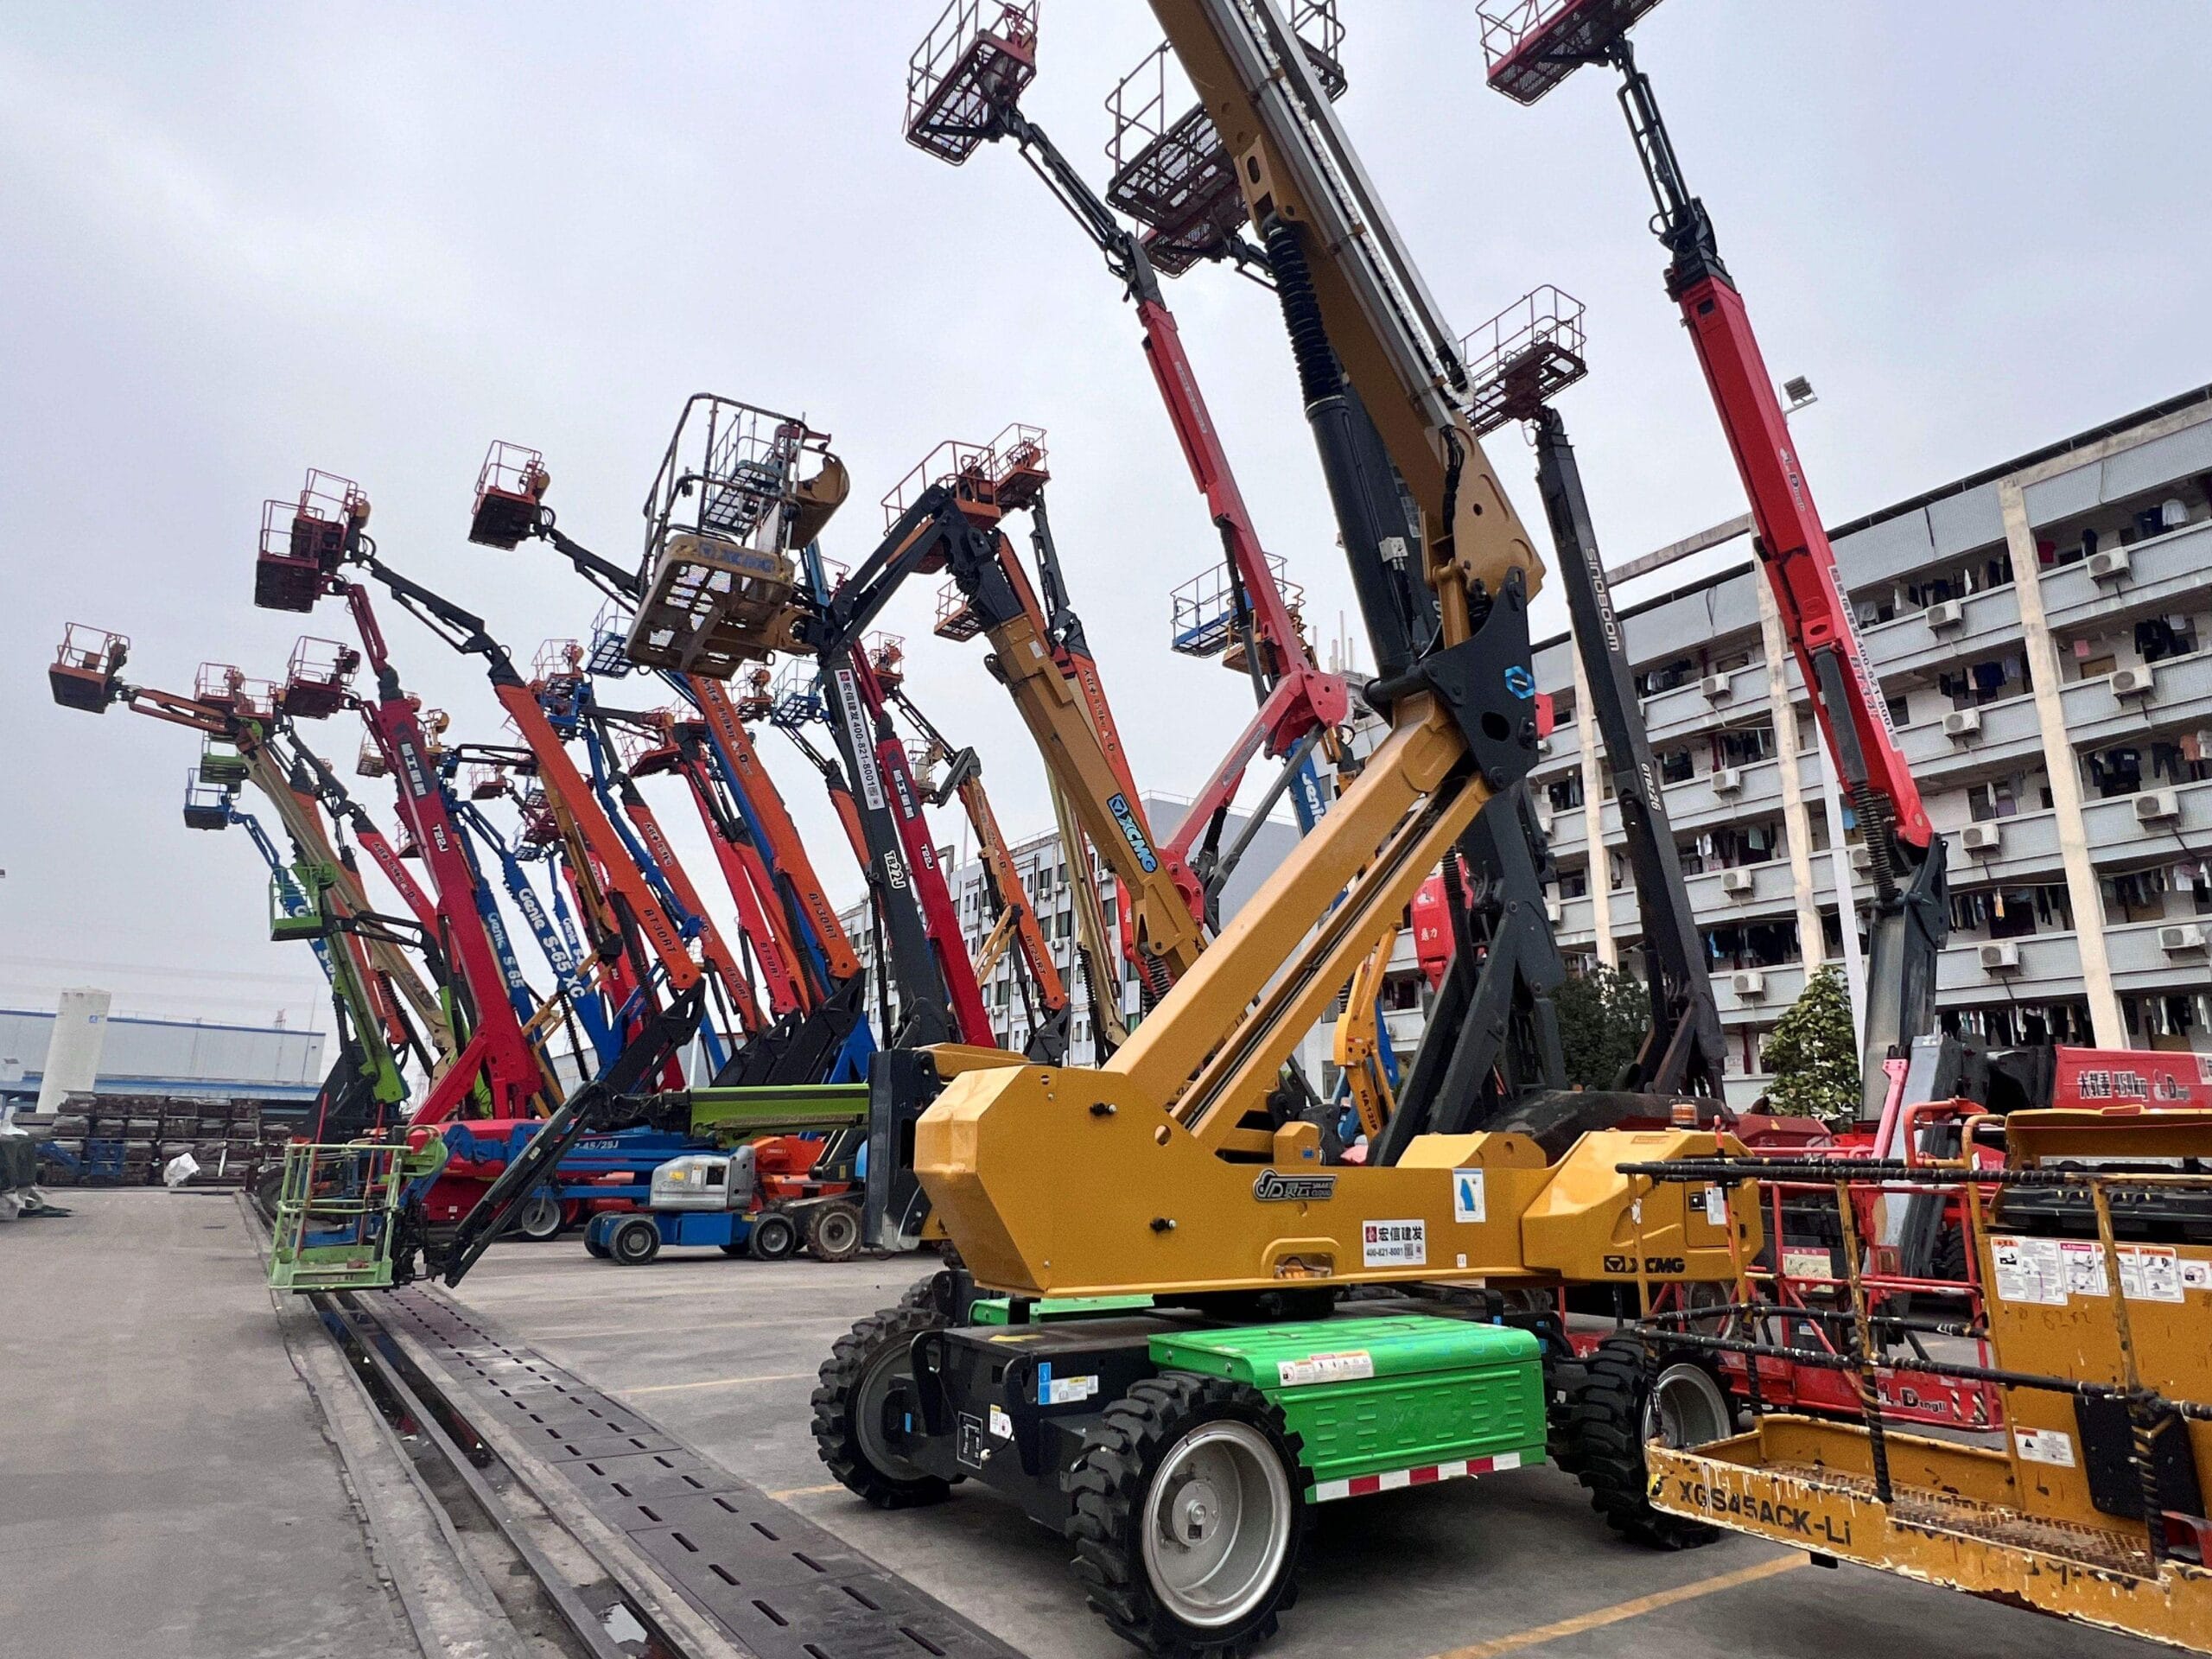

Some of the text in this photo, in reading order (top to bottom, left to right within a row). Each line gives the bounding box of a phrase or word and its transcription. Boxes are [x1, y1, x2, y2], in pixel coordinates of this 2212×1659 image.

[1857, 640, 1895, 734] 400-821-8001
[852, 721, 877, 787] 400-821-8001
[431, 823, 449, 853] T22J
[921, 843, 934, 870] T22J
[1117, 814, 1159, 874] XCMG
[884, 850, 906, 890] TB22J
[487, 912, 525, 988] Genie S-65
[518, 887, 586, 999] Genie S-65 XC
[562, 918, 576, 944] Genie
[1366, 1246, 1403, 1256] 400-821-8001
[1378, 1225, 1423, 1242] 宏信建发
[1678, 1479, 1853, 1548] XGS45ACK-Li
